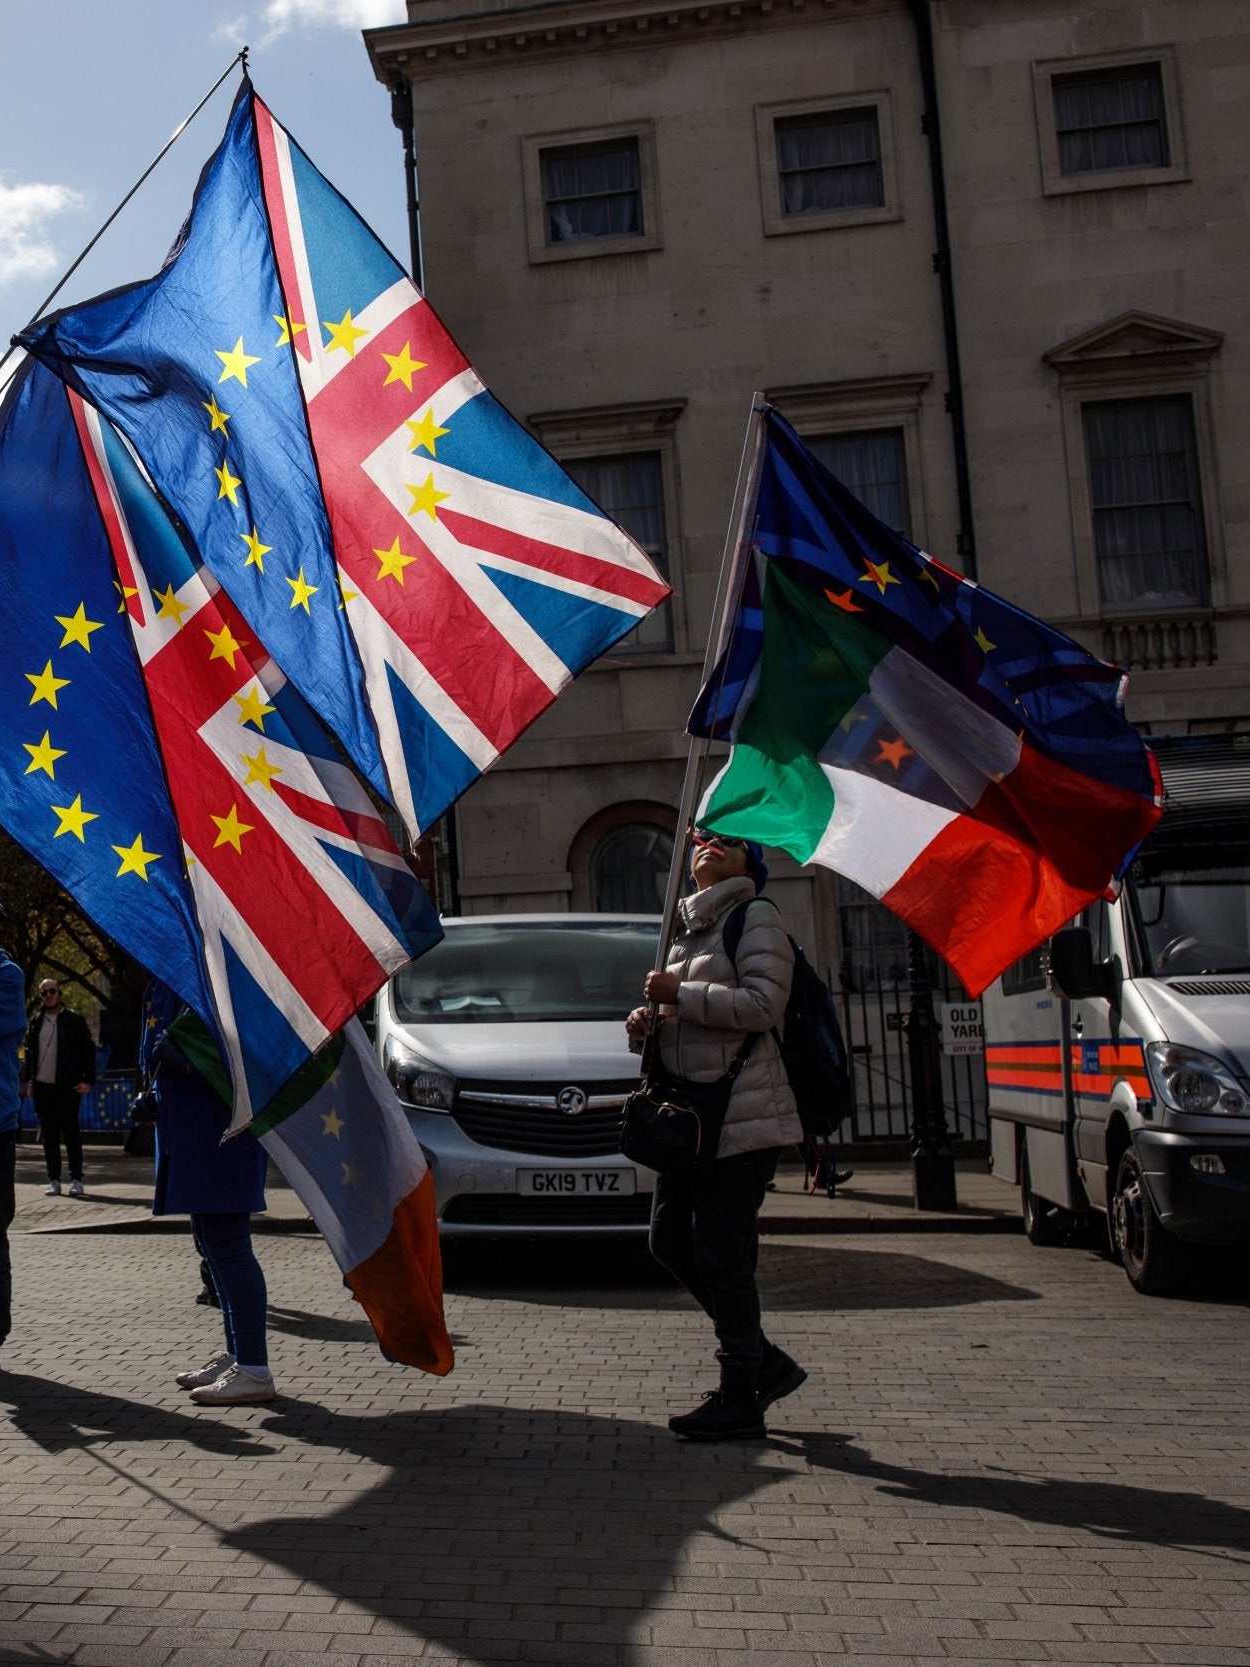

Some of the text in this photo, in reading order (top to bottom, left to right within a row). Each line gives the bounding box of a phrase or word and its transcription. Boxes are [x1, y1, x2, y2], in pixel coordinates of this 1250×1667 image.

[951, 1009, 978, 1022] OLD
[532, 1173, 619, 1191] GK19 TVZ
